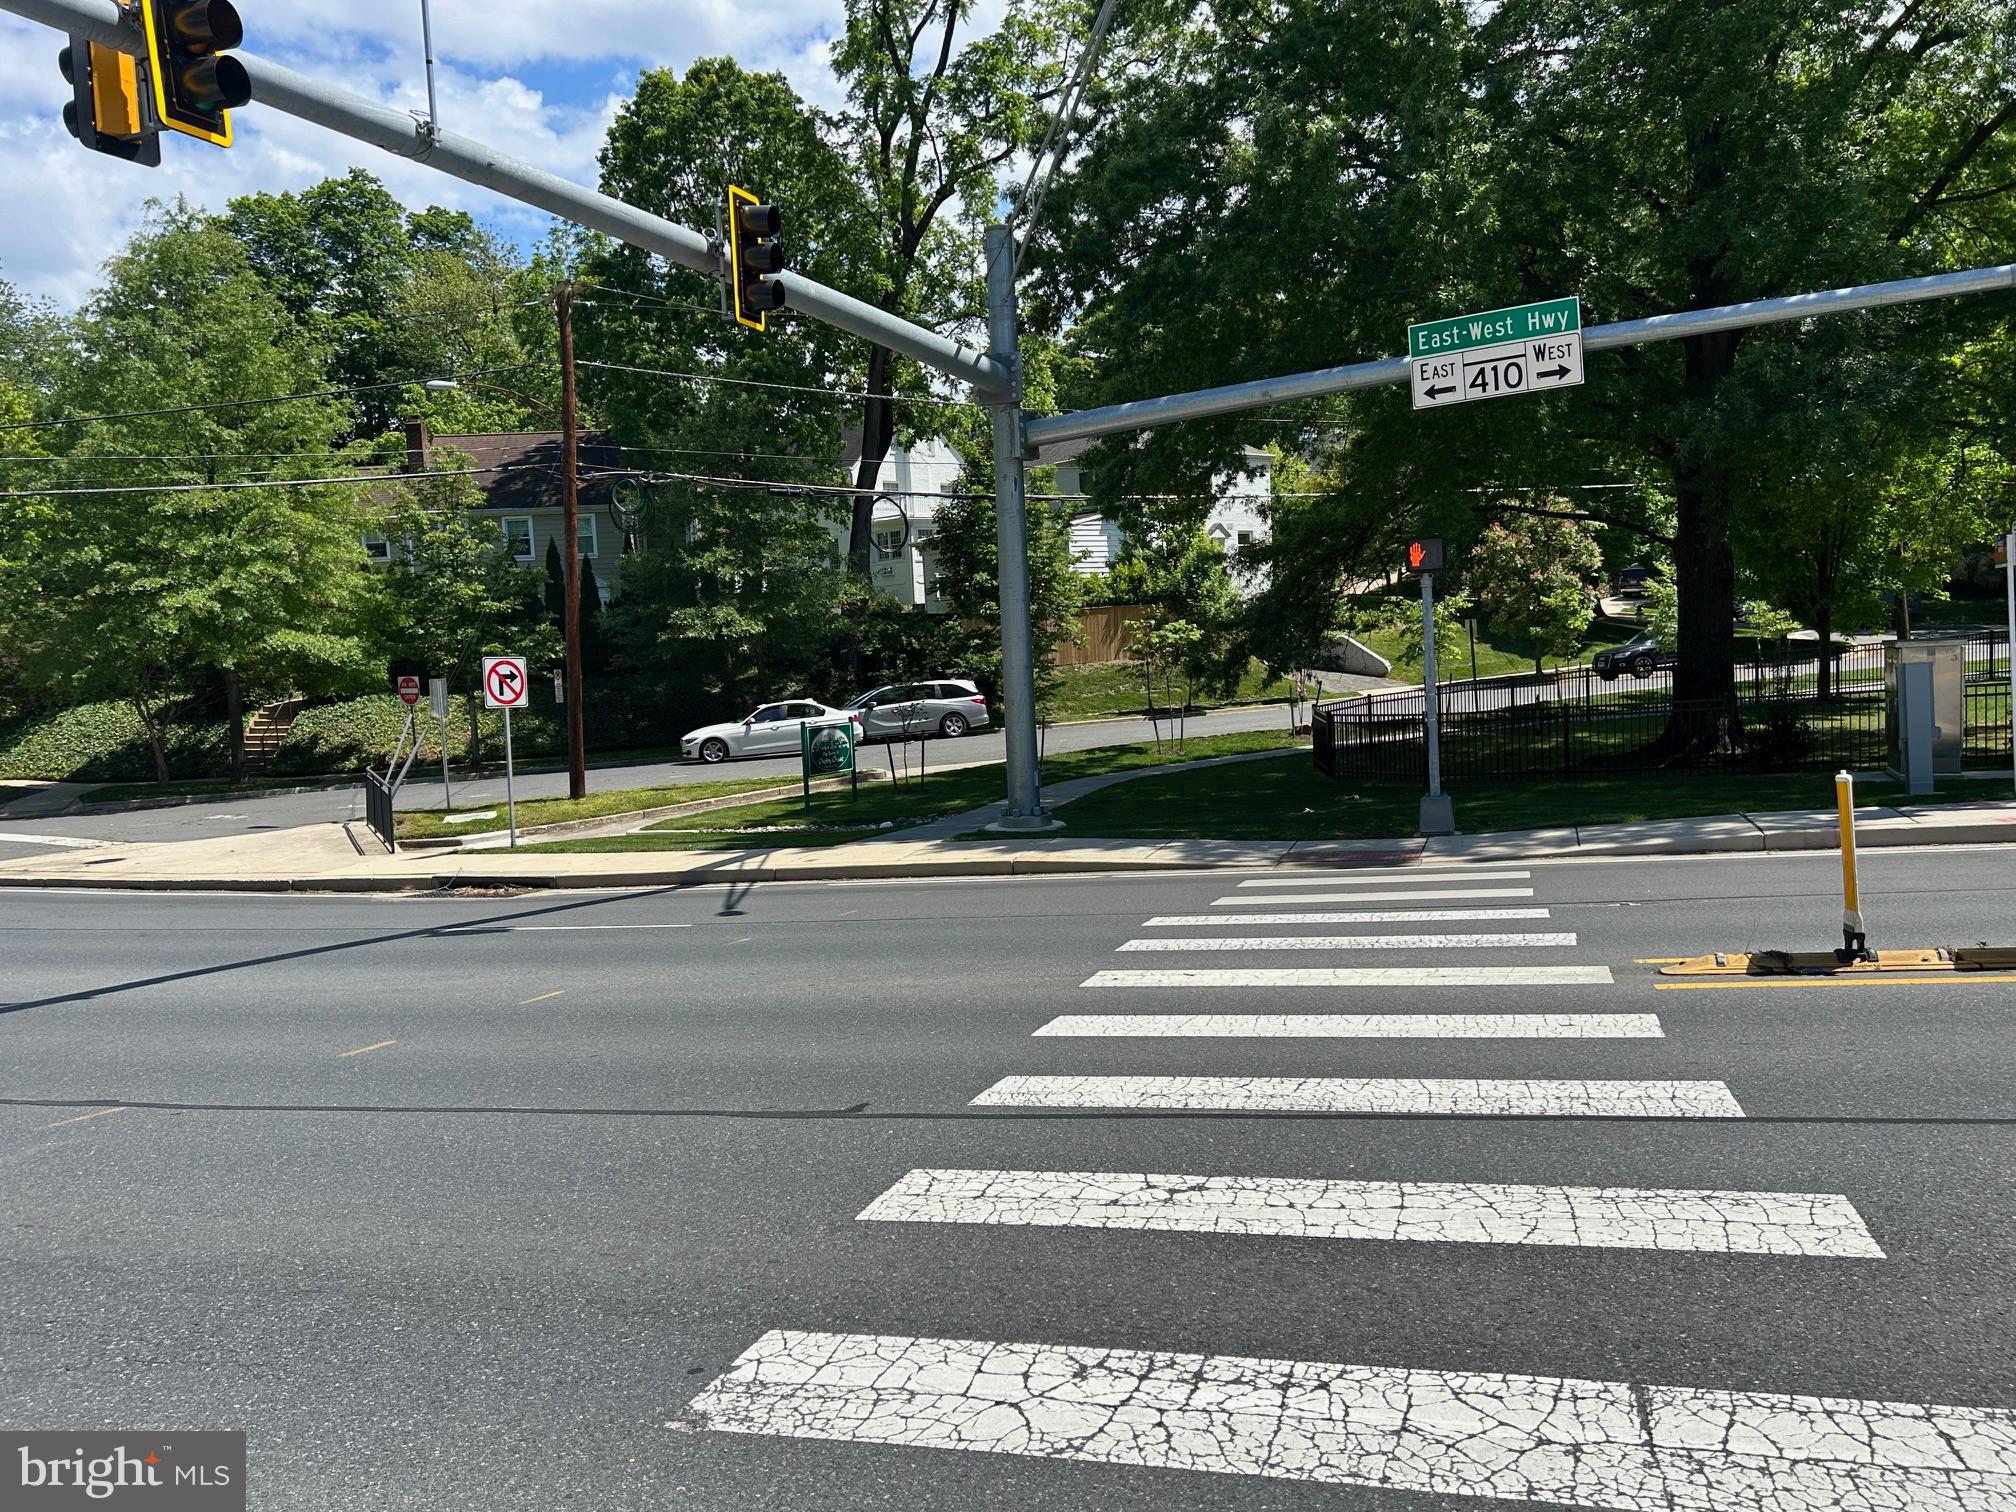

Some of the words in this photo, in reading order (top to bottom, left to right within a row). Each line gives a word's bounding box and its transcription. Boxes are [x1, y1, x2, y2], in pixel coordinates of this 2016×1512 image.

[1418, 317, 1514, 350] East-West
[1527, 310, 1569, 331] Hwy
[1532, 342, 1573, 363] WEST
[1420, 362, 1456, 381] EAST
[1469, 361, 1523, 394] 410
